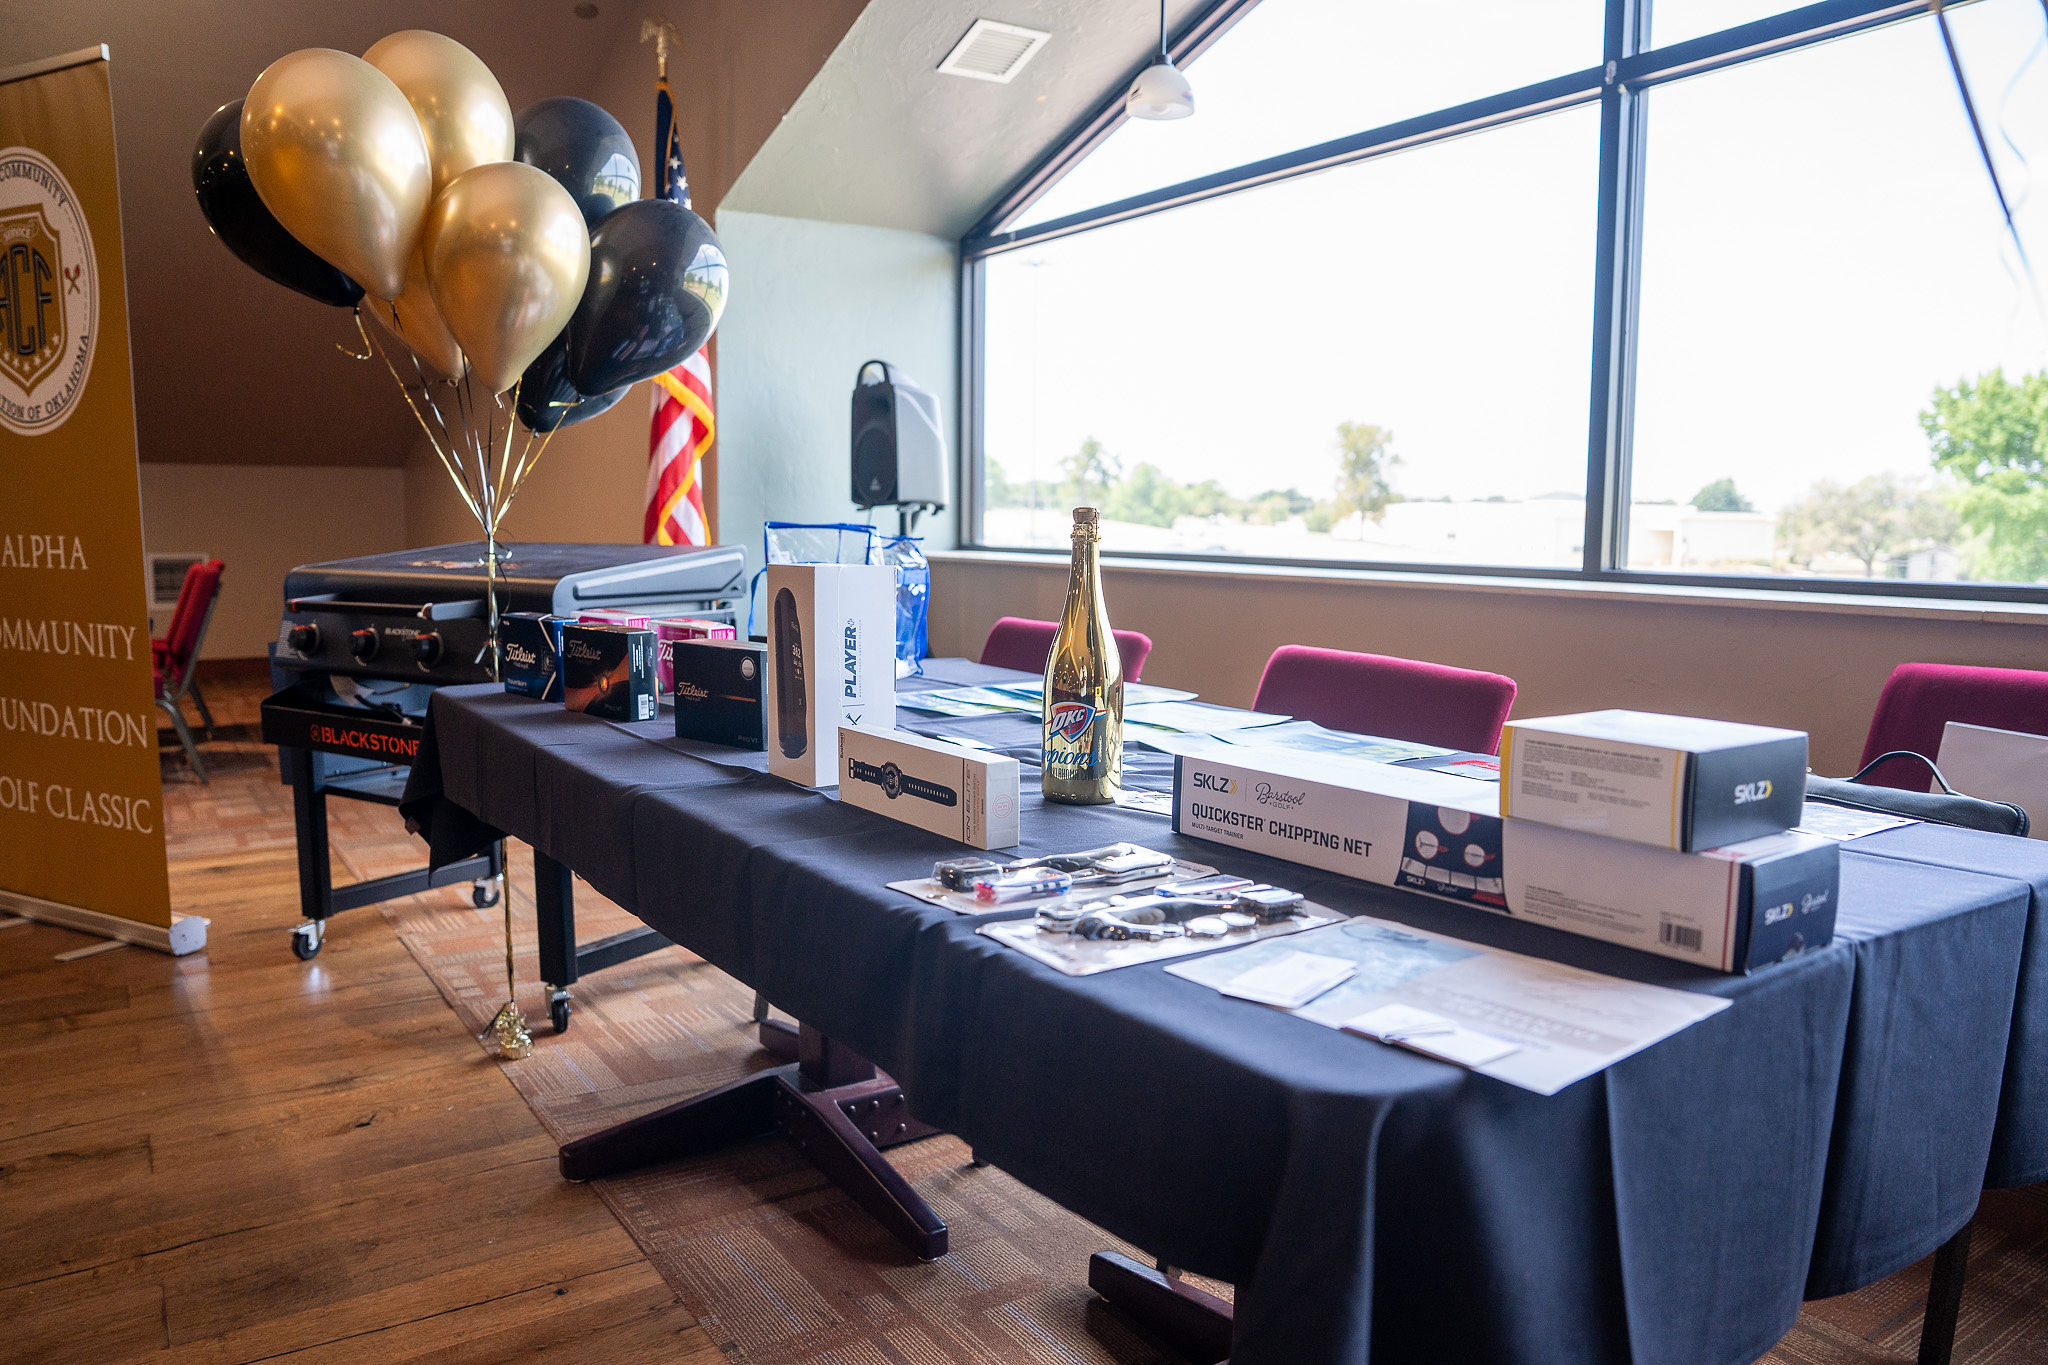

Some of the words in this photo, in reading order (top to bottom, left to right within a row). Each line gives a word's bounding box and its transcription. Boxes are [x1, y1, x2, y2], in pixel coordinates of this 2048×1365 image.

[27, 405, 42, 419] OF
[44, 335, 89, 415] OKLAHOMA
[1, 534, 89, 570] ALPHA
[0, 617, 136, 660] MMUNITY
[505, 643, 537, 664] Titleist
[676, 682, 710, 698] Titleist
[0, 697, 148, 748] UNDATION
[1050, 708, 1085, 734] OKC
[1193, 772, 1230, 794] SKLZ
[1255, 782, 1306, 805] Barstool
[1734, 780, 1767, 805] SKLZ
[0, 775, 39, 813] OLF
[46, 784, 153, 834] CLASSIC
[1272, 801, 1290, 810] GOLF
[1191, 821, 1223, 835] MULTI-TARGET
[1223, 829, 1244, 839] TRAINER
[1192, 802, 1264, 832] QUICKSTER
[1269, 820, 1340, 850] CHIPPING
[1344, 837, 1373, 857] NET
